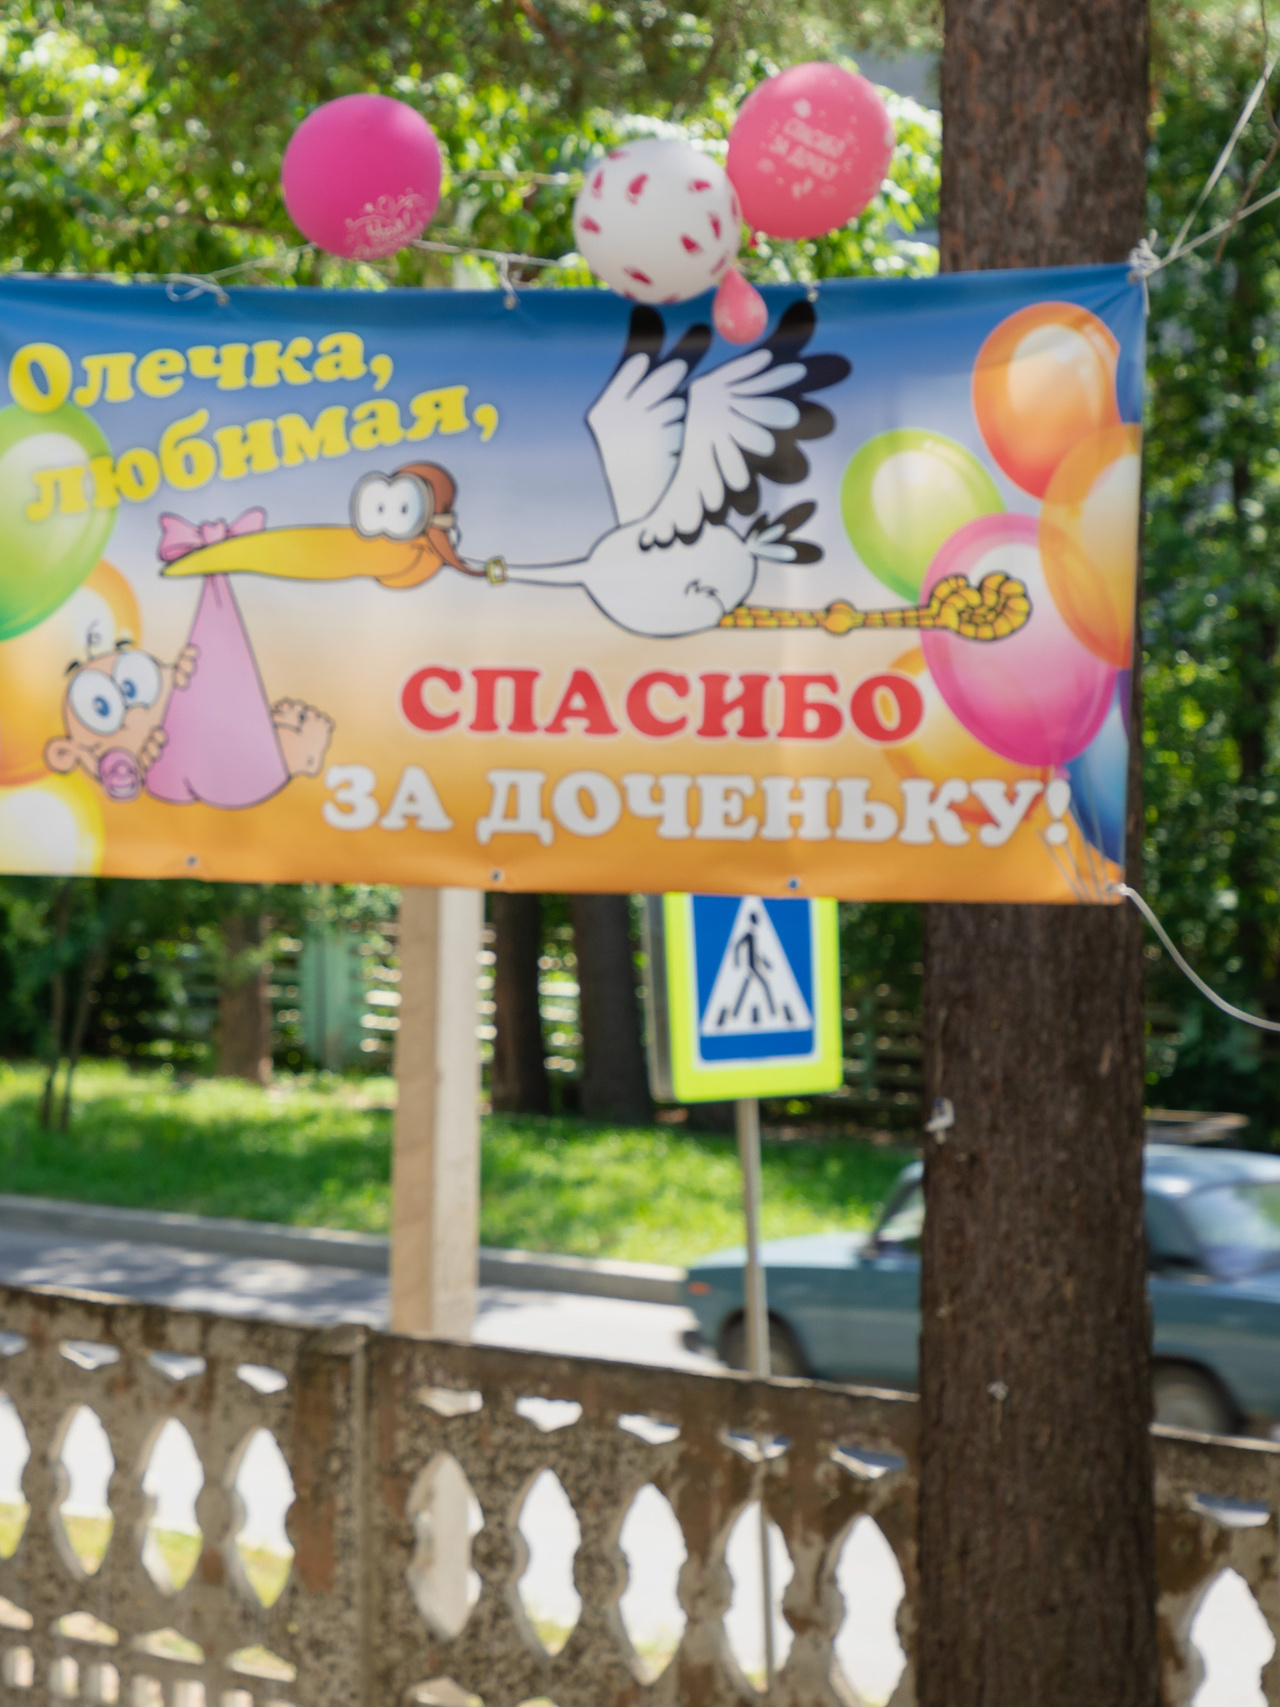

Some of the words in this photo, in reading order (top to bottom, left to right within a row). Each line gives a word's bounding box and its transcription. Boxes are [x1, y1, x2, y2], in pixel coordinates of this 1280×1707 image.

[8, 332, 394, 414] Олечка,
[26, 385, 499, 521] любимая,
[401, 666, 924, 743] СПАСИБО
[322, 764, 453, 831] ЗА
[477, 769, 1072, 847] ДОЧЕНЬКУ!
